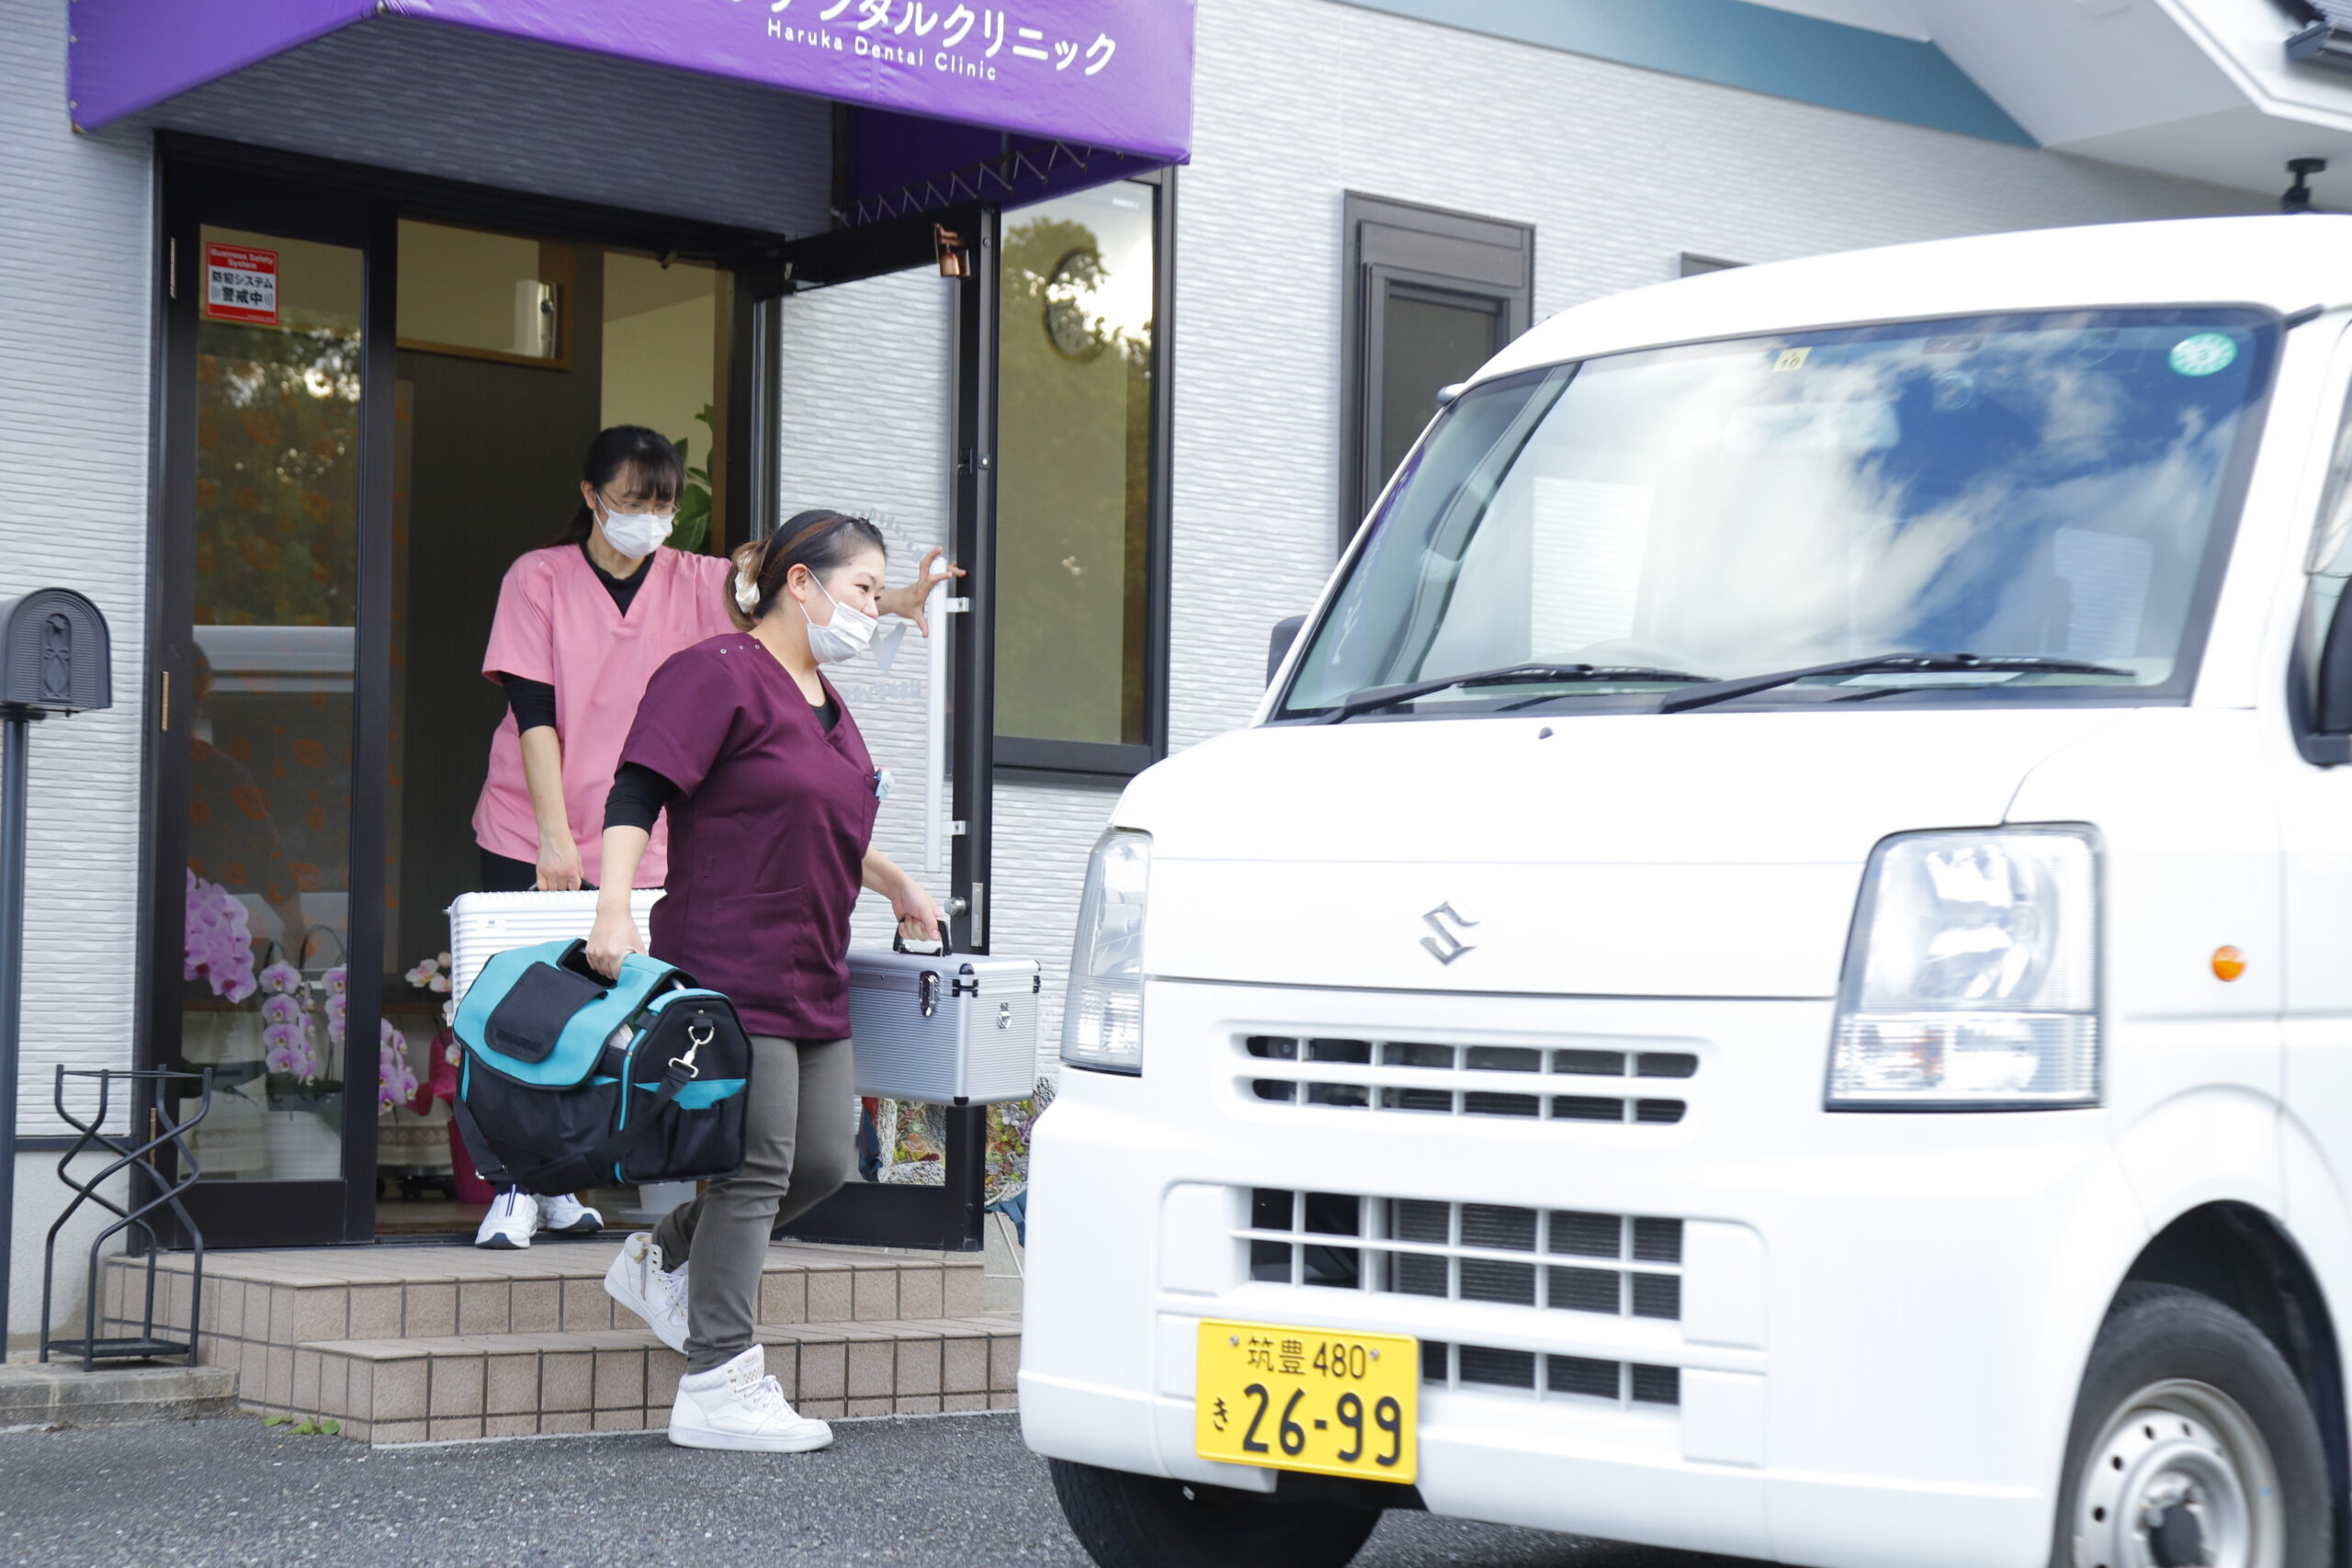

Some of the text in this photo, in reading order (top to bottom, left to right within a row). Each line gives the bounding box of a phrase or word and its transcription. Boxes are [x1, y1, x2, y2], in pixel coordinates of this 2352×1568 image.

[767, 17, 997, 81] Haruka Dental Clinic
[212, 270, 274, 288] 防犯システム
[222, 287, 263, 304] 警戒中
[1213, 1382, 1402, 1468] き 26-99
